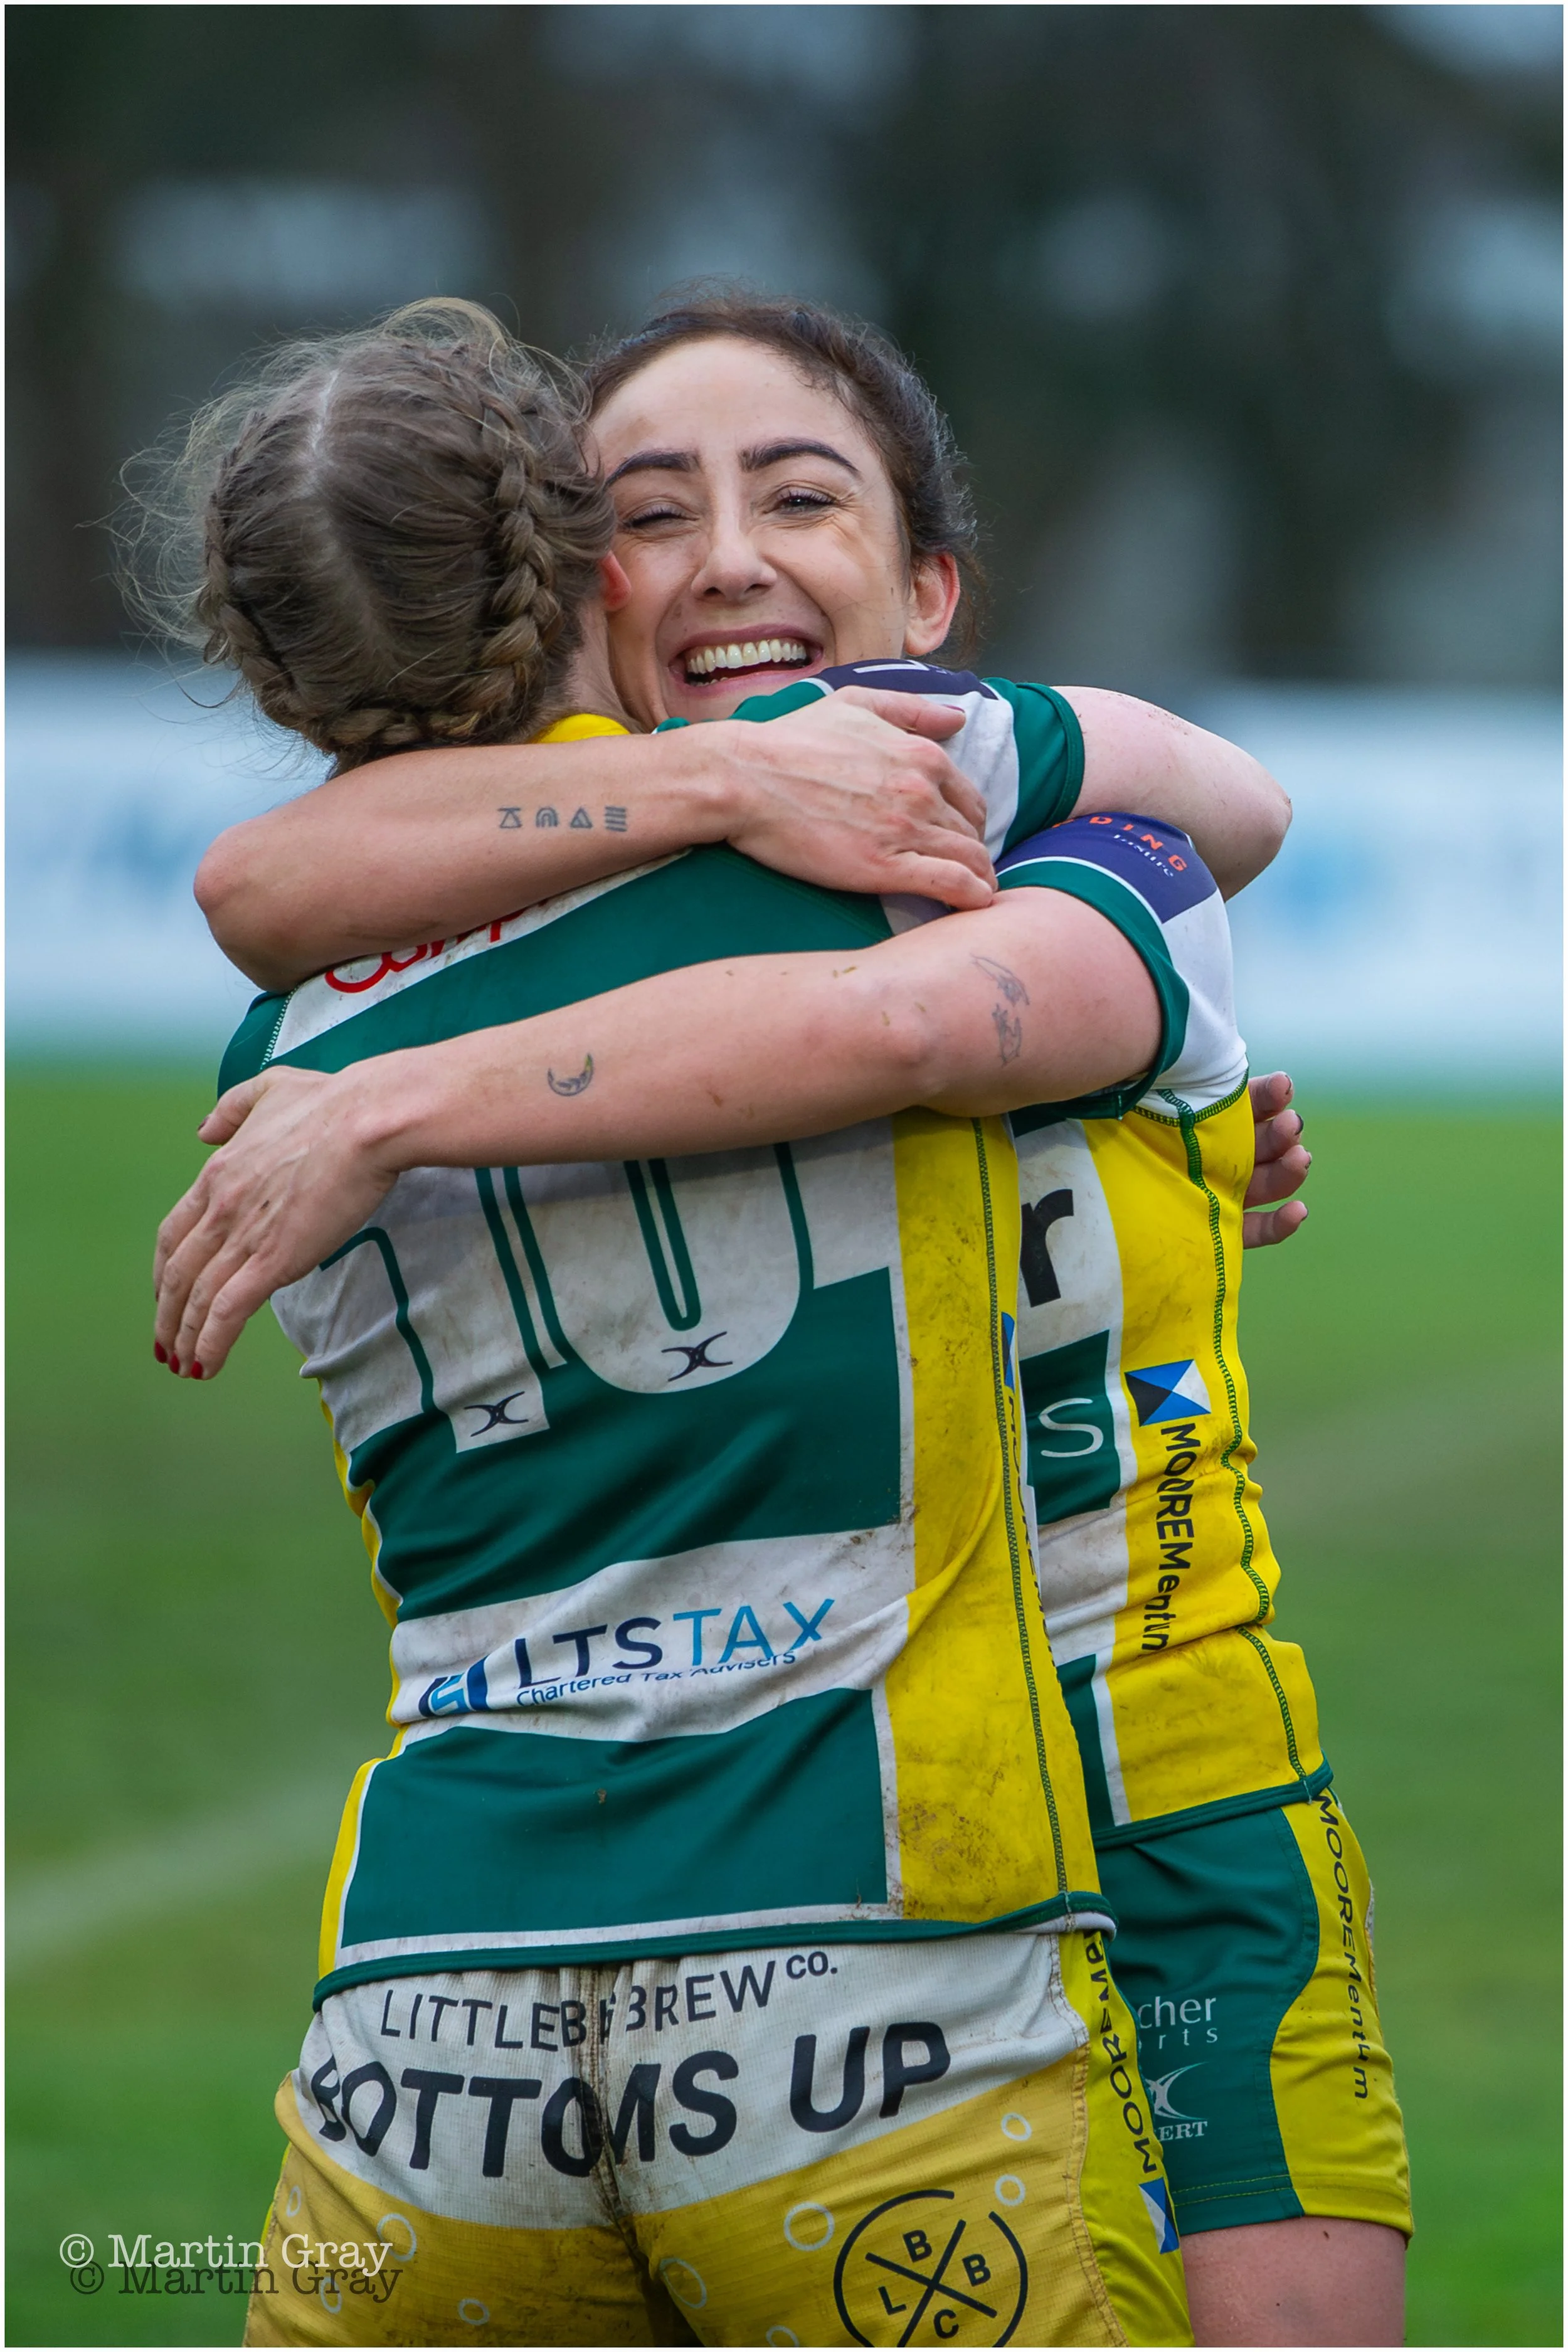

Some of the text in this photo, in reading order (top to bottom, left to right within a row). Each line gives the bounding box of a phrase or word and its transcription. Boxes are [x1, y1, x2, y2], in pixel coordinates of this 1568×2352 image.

[517, 1651, 796, 1707] Chartered Tax Advisers
[786, 1951, 837, 1980] CO.
[1318, 1795, 1372, 2100] MOOREMentum
[310, 2021, 951, 2178] BOTTOMS UP
